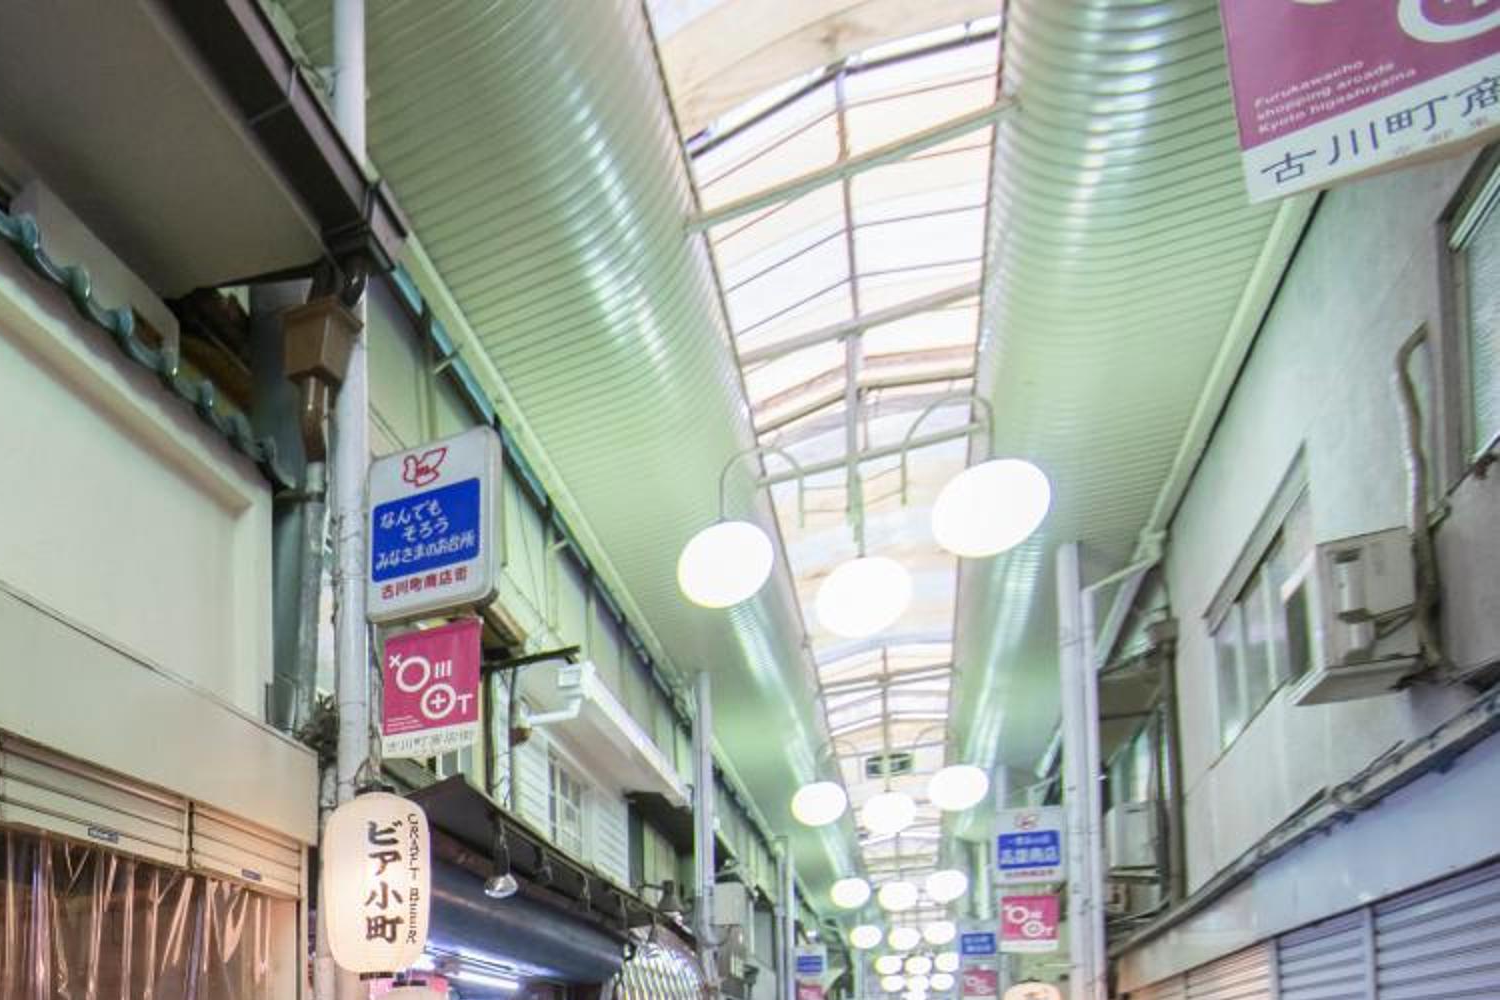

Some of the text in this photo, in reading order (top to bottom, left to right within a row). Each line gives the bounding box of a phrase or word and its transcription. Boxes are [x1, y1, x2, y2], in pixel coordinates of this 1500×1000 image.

[1256, 62, 1395, 121] shopping arcade
[1257, 111, 1309, 135] Kyoto
[380, 499, 442, 528] なんでも
[402, 520, 449, 542] そろう
[374, 531, 476, 570] みなさまのお台所
[381, 566, 469, 600] 古川町商店街
[364, 819, 404, 945] ビア小町
[406, 887, 419, 944] BEER
